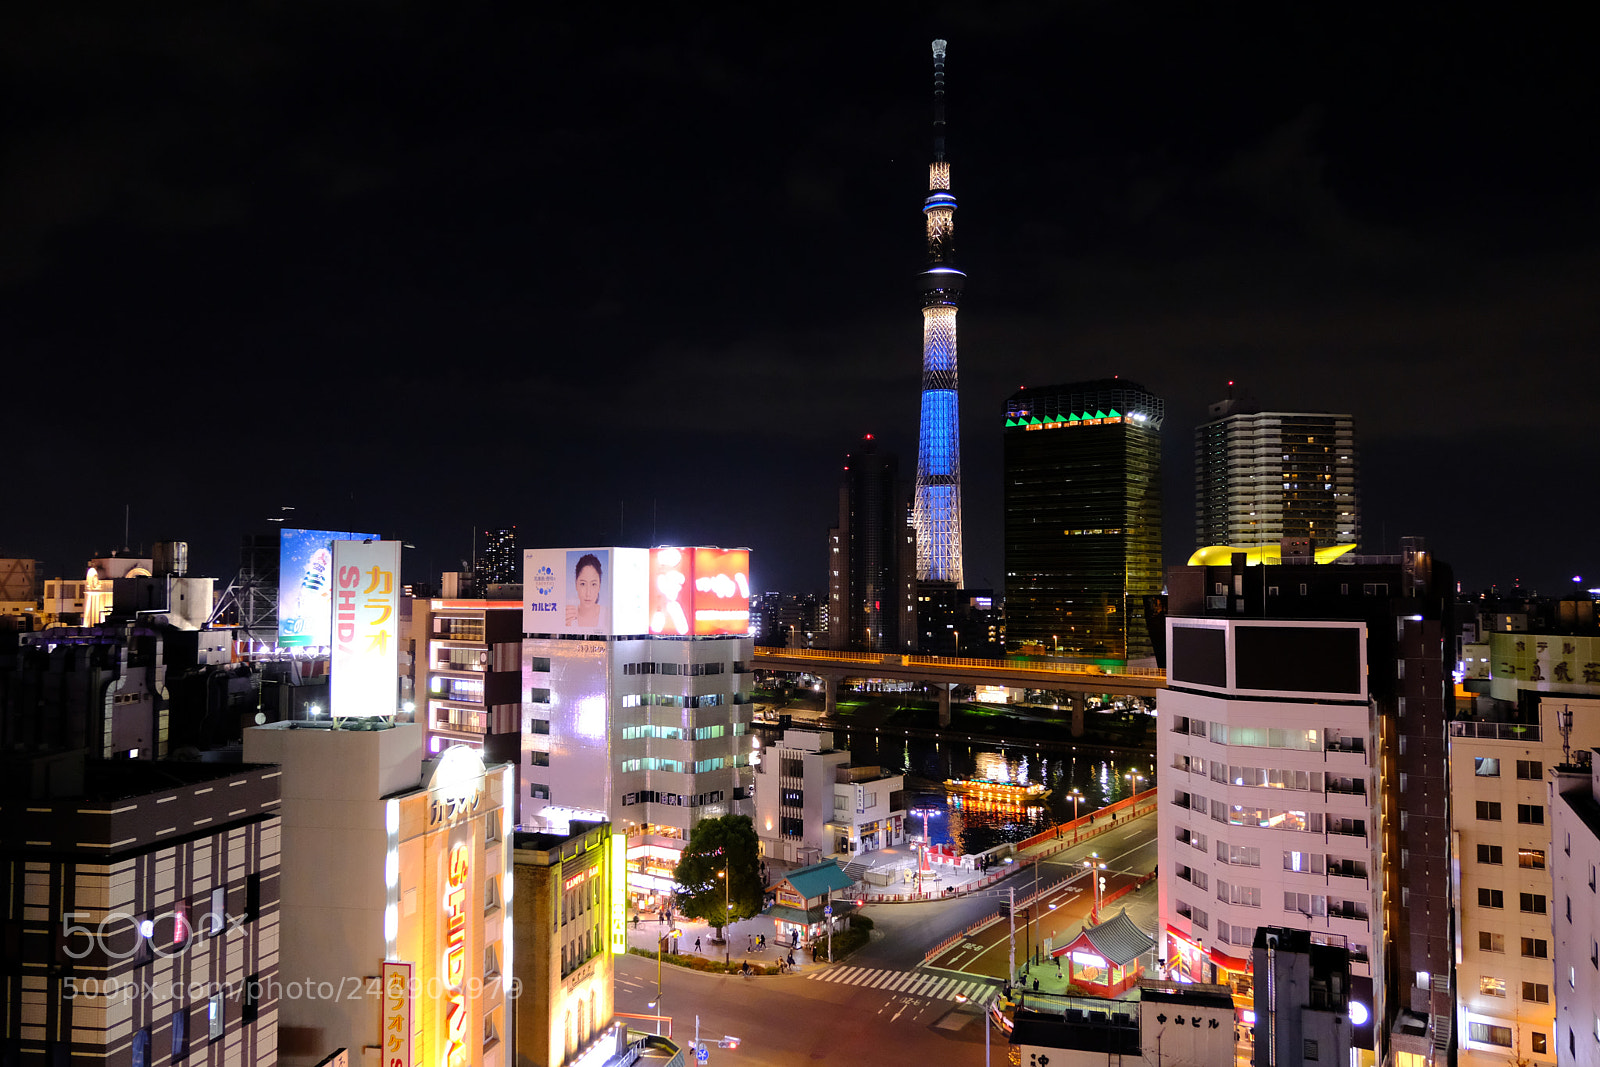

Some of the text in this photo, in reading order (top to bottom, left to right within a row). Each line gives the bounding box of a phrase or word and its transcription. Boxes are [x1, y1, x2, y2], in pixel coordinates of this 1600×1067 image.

[531, 602, 557, 612] カルピス
[1515, 640, 1575, 655] ホテル
[388, 971, 406, 1052] カラオケ
[1156, 1013, 1220, 1030] 中山ビル
